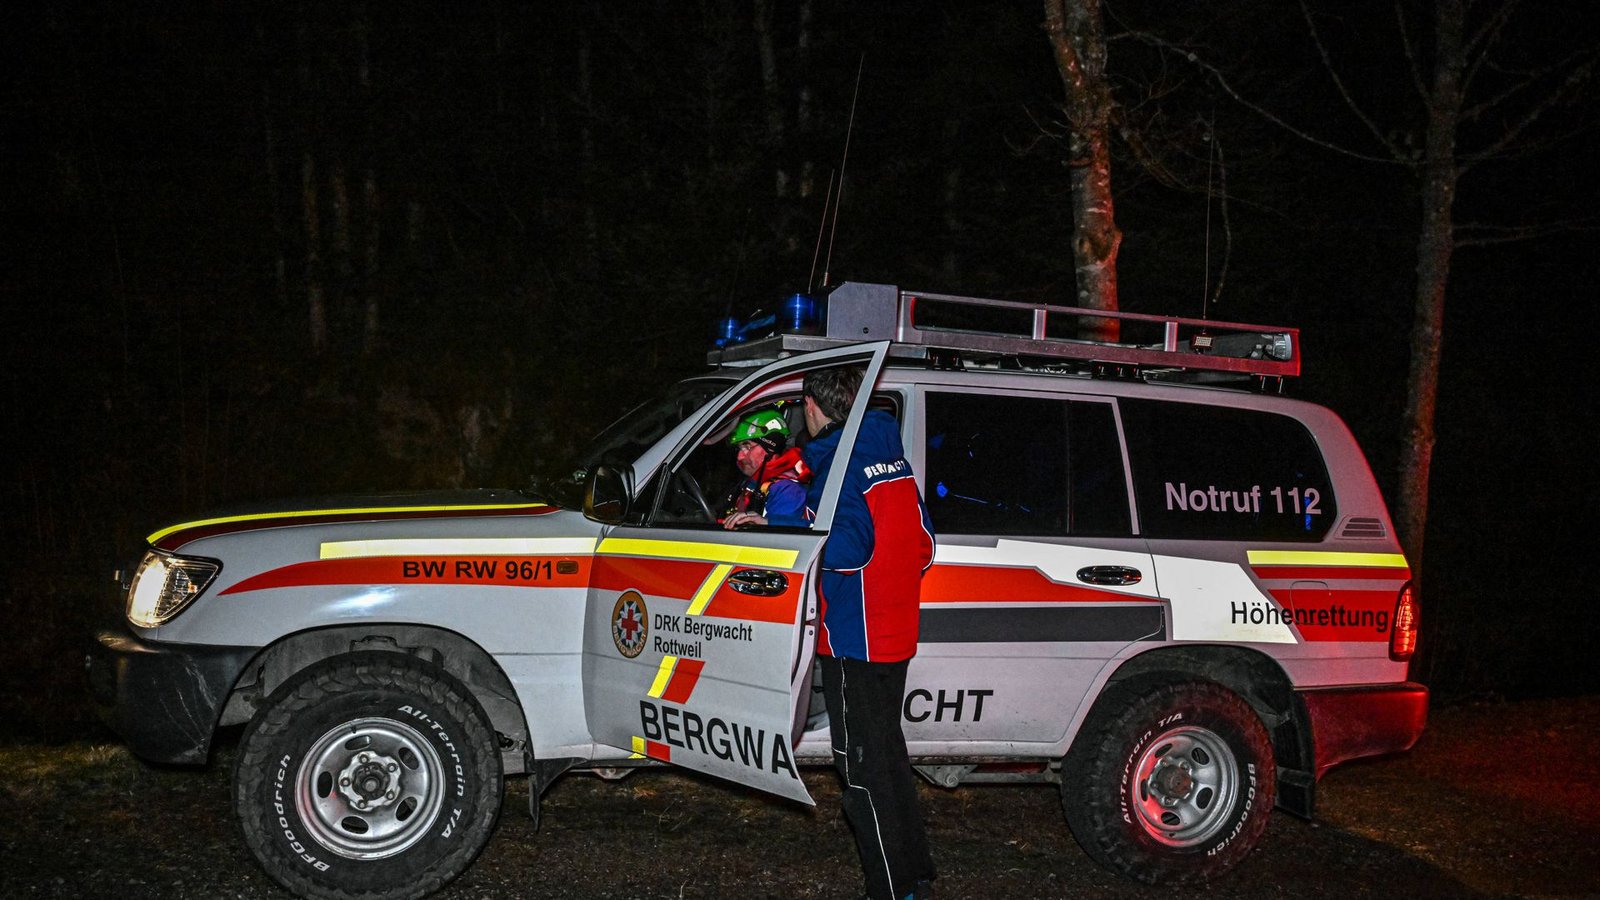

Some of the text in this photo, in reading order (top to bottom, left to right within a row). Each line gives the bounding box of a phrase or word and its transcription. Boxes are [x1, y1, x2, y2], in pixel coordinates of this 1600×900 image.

[1164, 482, 1322, 515] Notruf 112
[403, 561, 552, 580] BW RW 96/1
[654, 613, 753, 642] DRK Bergwacht
[1230, 601, 1389, 632] Höhenrettung
[654, 637, 702, 658] Rottweil
[903, 688, 994, 723] CHT
[639, 700, 799, 780] BERGWA
[398, 704, 466, 839] All-Terrain T/A
[1119, 712, 1184, 824] All-Terrain T/A
[274, 754, 331, 872] BFGoodrich
[1207, 763, 1257, 856] BFGoodrich
